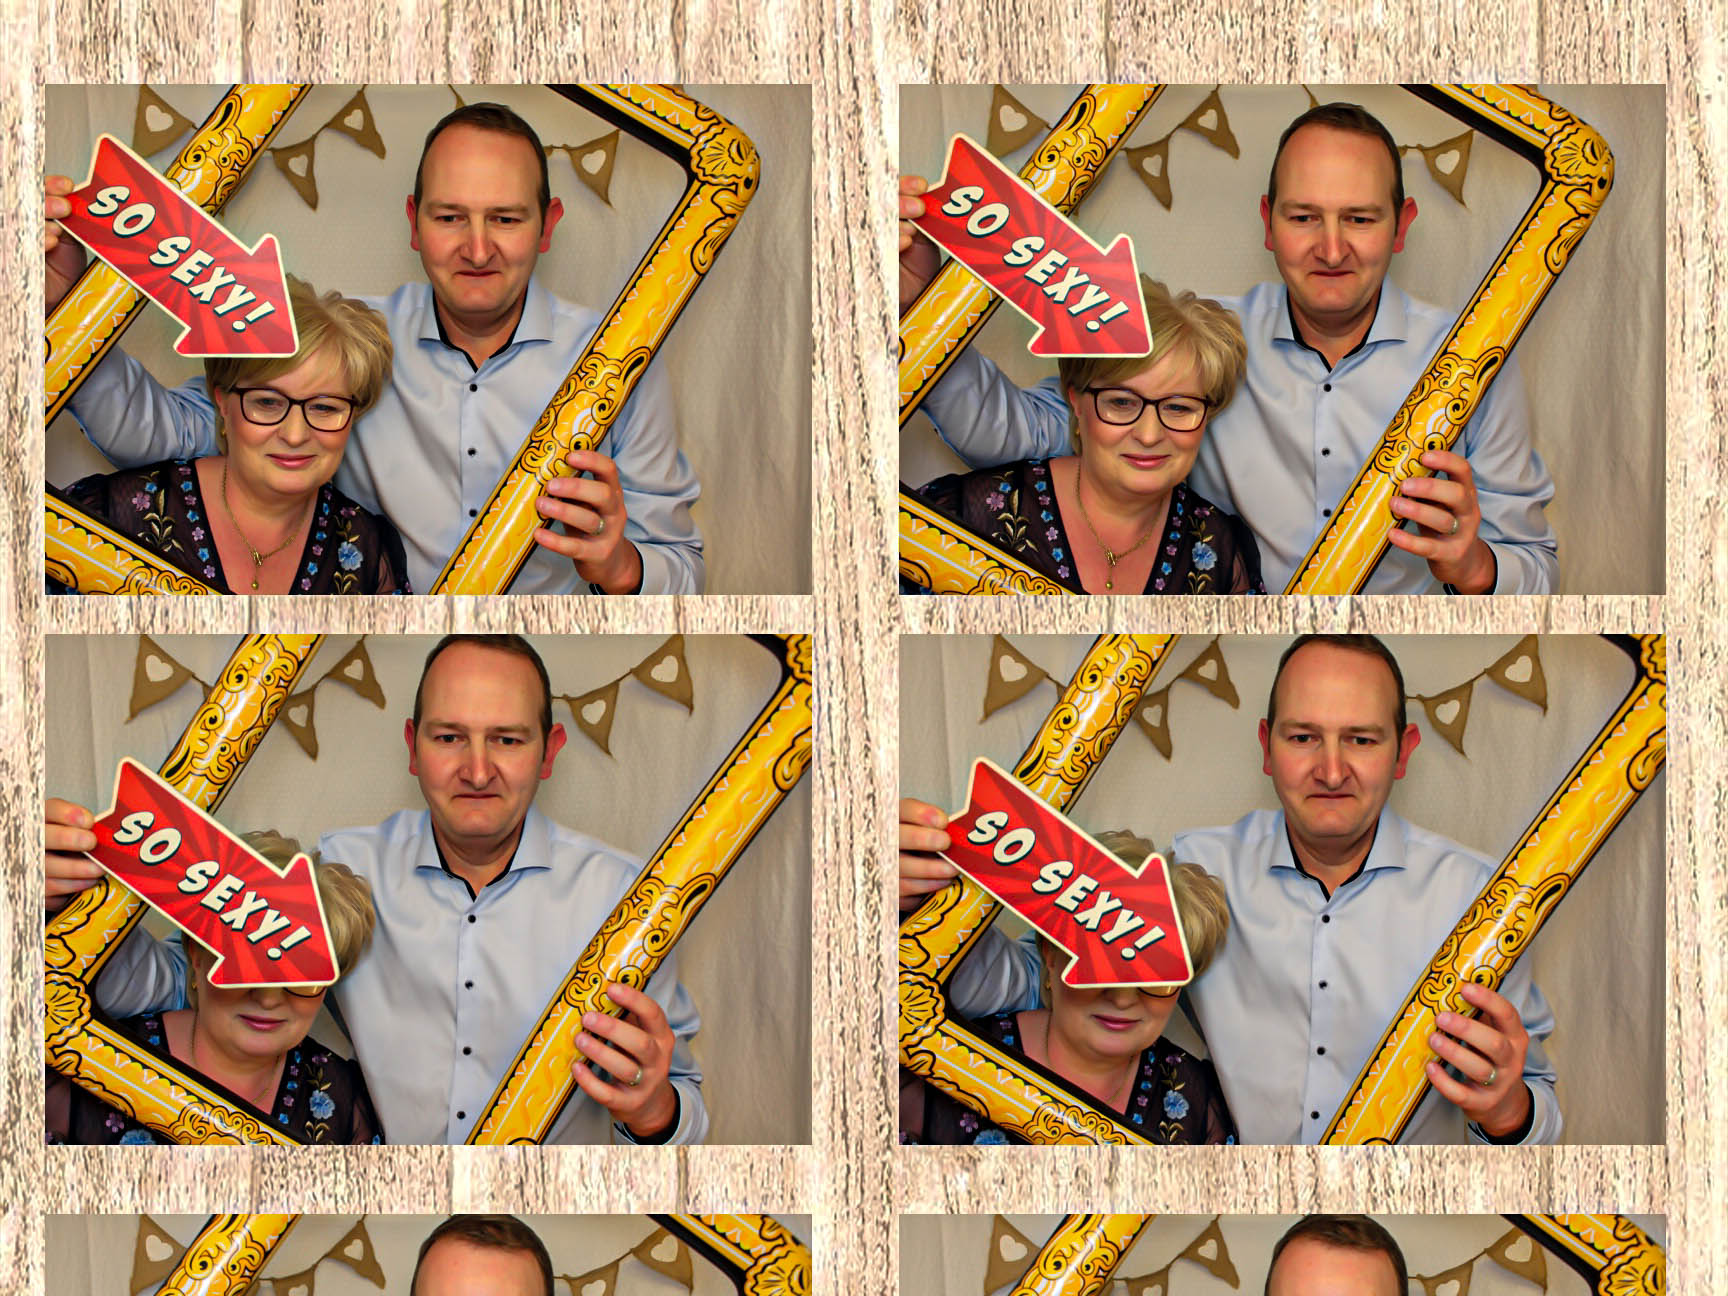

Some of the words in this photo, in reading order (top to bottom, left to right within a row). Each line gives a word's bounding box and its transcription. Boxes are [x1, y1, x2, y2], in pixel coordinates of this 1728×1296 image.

[88, 186, 156, 238] SO
[149, 236, 275, 333] SEXY!
[942, 186, 1010, 238] SO
[1003, 236, 1129, 333] SEXY!
[113, 811, 182, 865] SO
[178, 861, 311, 960] SEXY!
[967, 811, 1036, 865] SO
[1032, 861, 1165, 960] SEXY!
